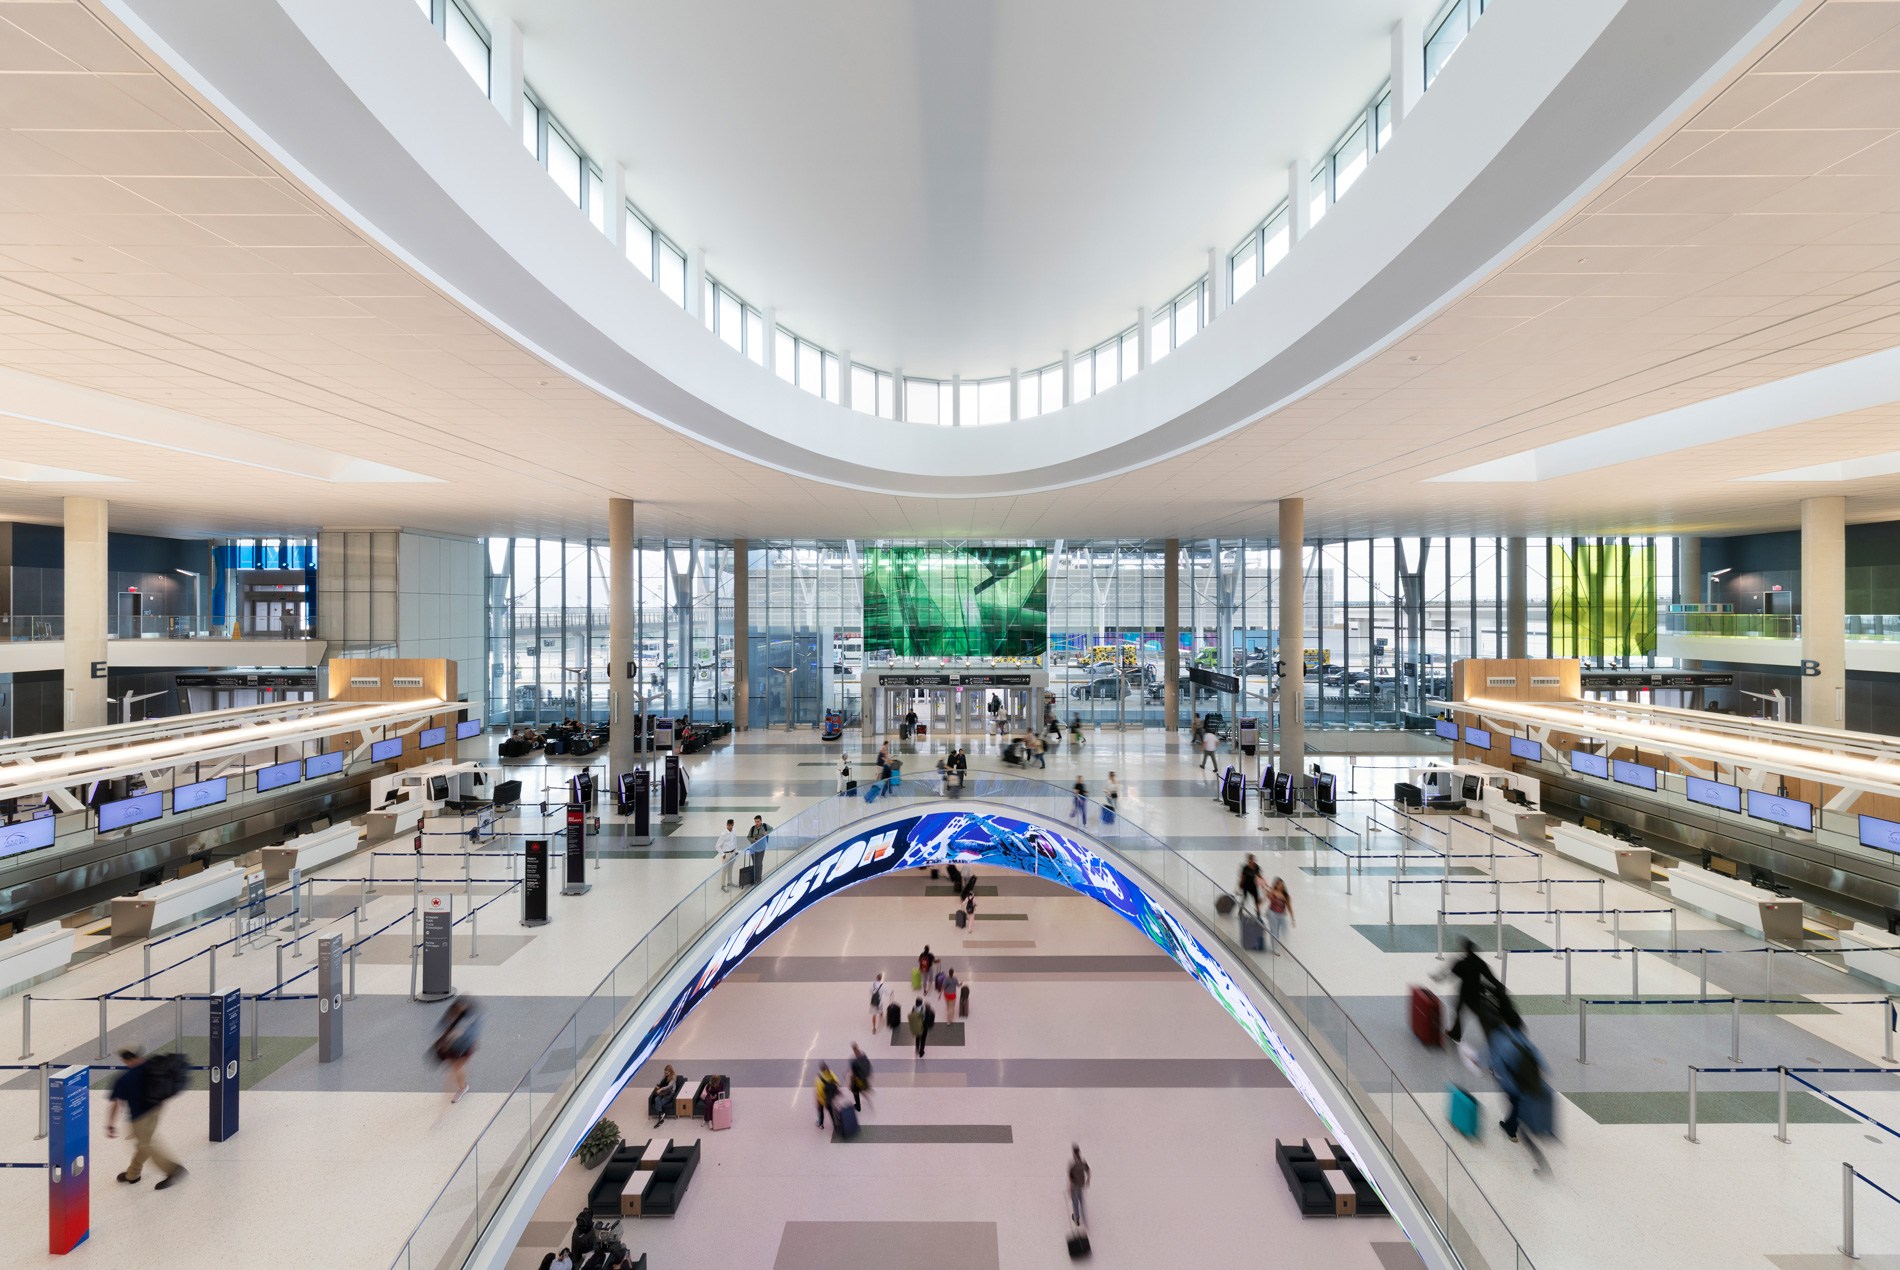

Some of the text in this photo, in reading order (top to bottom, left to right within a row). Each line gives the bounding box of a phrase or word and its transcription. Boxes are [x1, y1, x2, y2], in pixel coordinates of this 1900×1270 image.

[90, 661, 107, 678] E
[626, 661, 637, 679] D
[1276, 661, 1287, 678] C
[1800, 659, 1822, 677] B
[689, 829, 898, 998] HOUSTON
